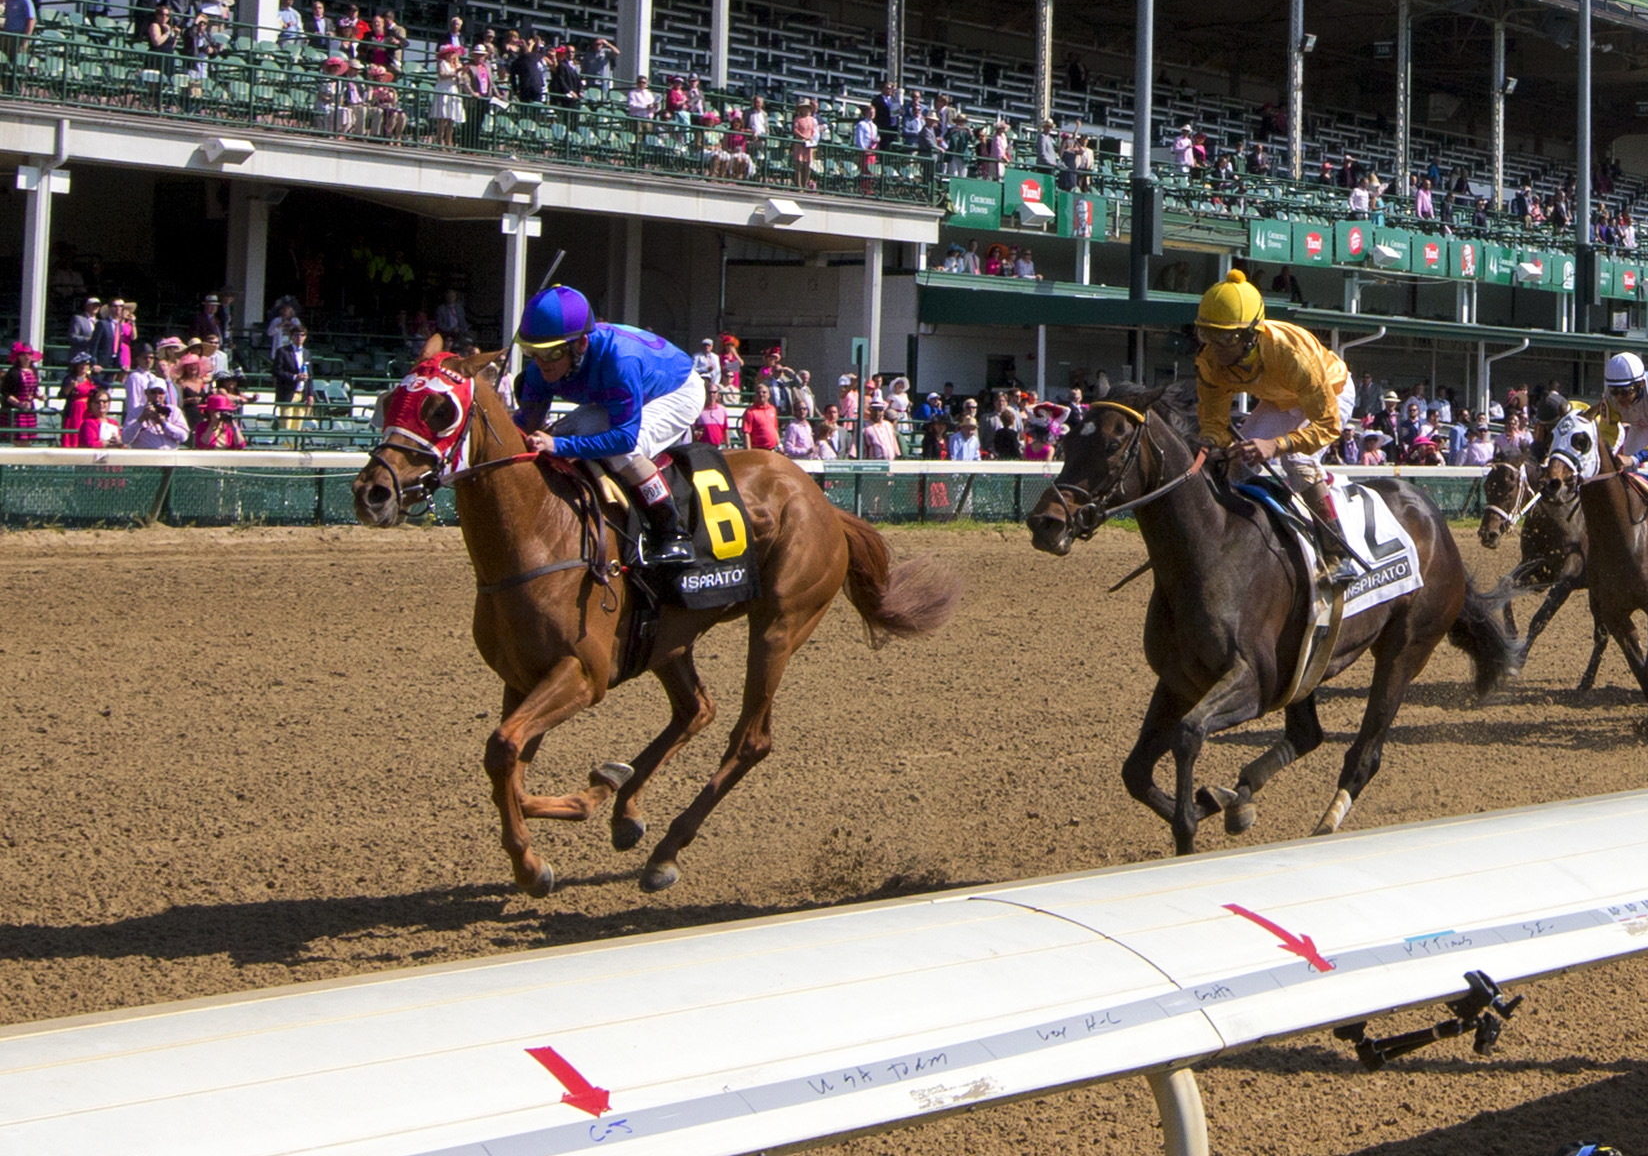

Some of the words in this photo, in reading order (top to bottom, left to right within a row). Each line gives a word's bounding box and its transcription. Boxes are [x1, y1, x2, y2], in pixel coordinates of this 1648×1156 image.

[1021, 184, 1041, 200] Yum!
[693, 469, 747, 560] 6
[1343, 563, 1407, 602] INSPIRATO
